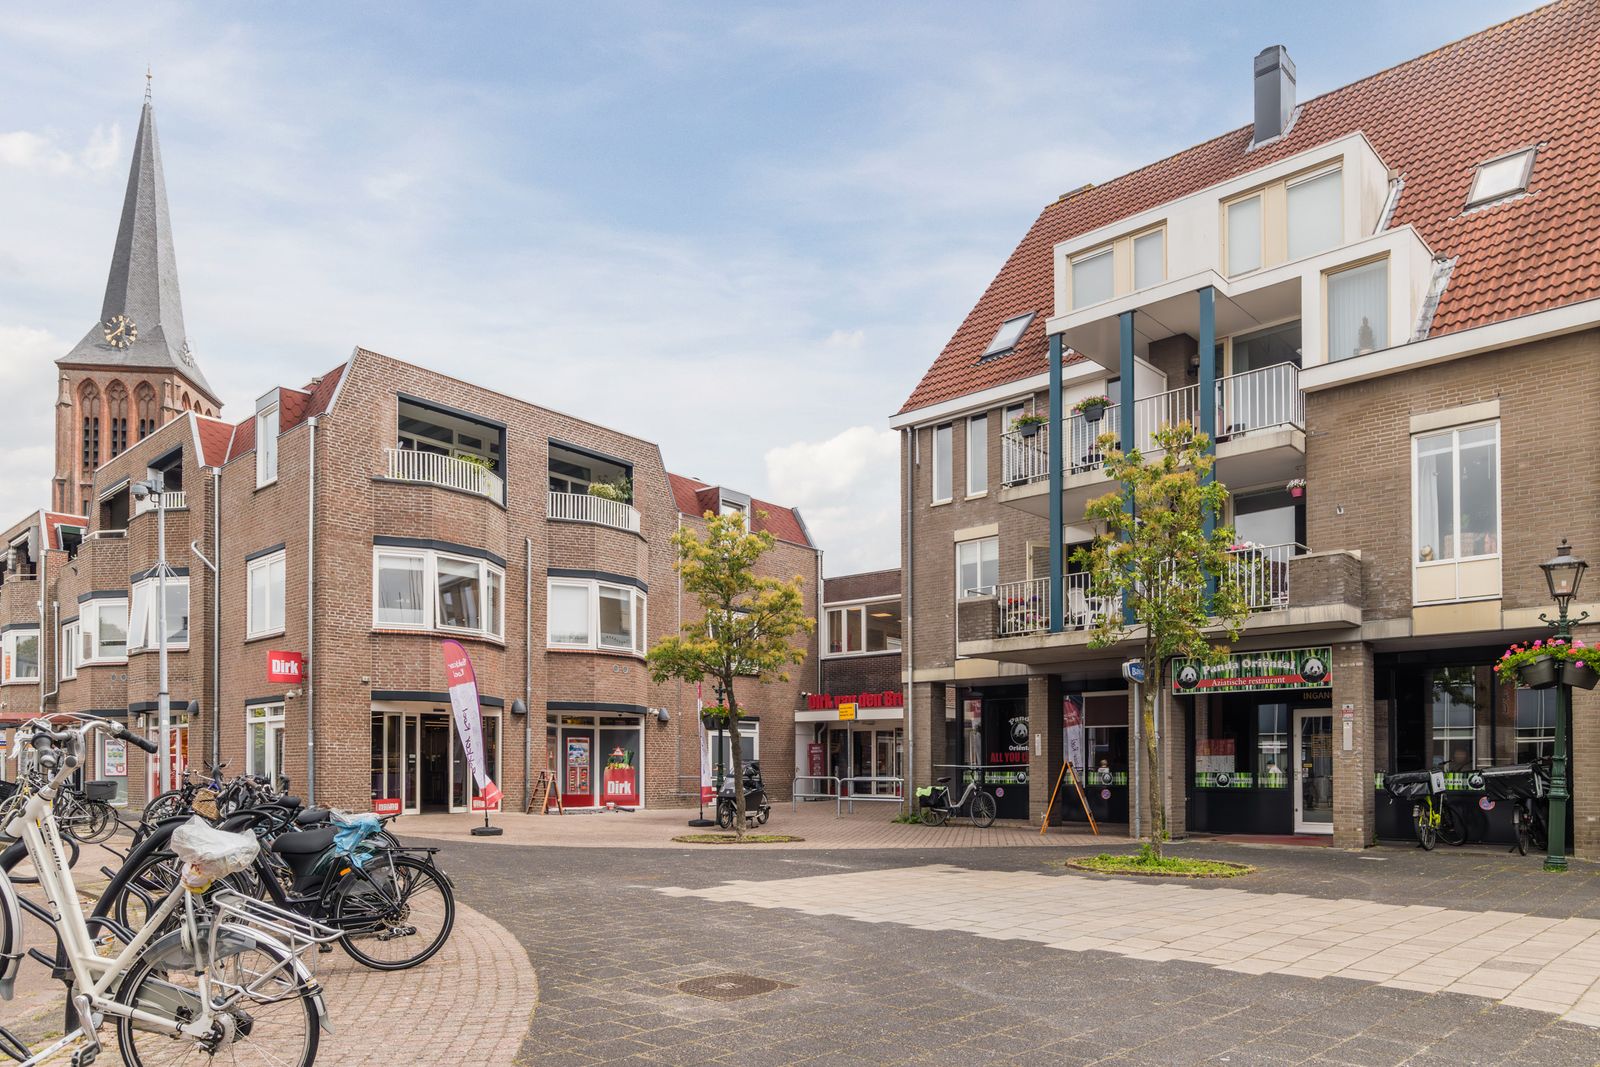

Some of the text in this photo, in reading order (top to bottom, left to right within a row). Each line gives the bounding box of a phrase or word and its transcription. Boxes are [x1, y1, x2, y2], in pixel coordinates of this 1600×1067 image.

[271, 659, 299, 675] Dirk
[1203, 661, 1239, 675] Panda
[1211, 677, 1285, 687] Aziatische restaurant
[808, 693, 832, 710] Dirk
[859, 692, 882, 708] den
[1303, 692, 1332, 700] INGAN
[991, 752, 1003, 763] ALL
[1004, 752, 1020, 763] YOU
[607, 781, 632, 795] Dirk
[44, 823, 62, 871] Gazelle
